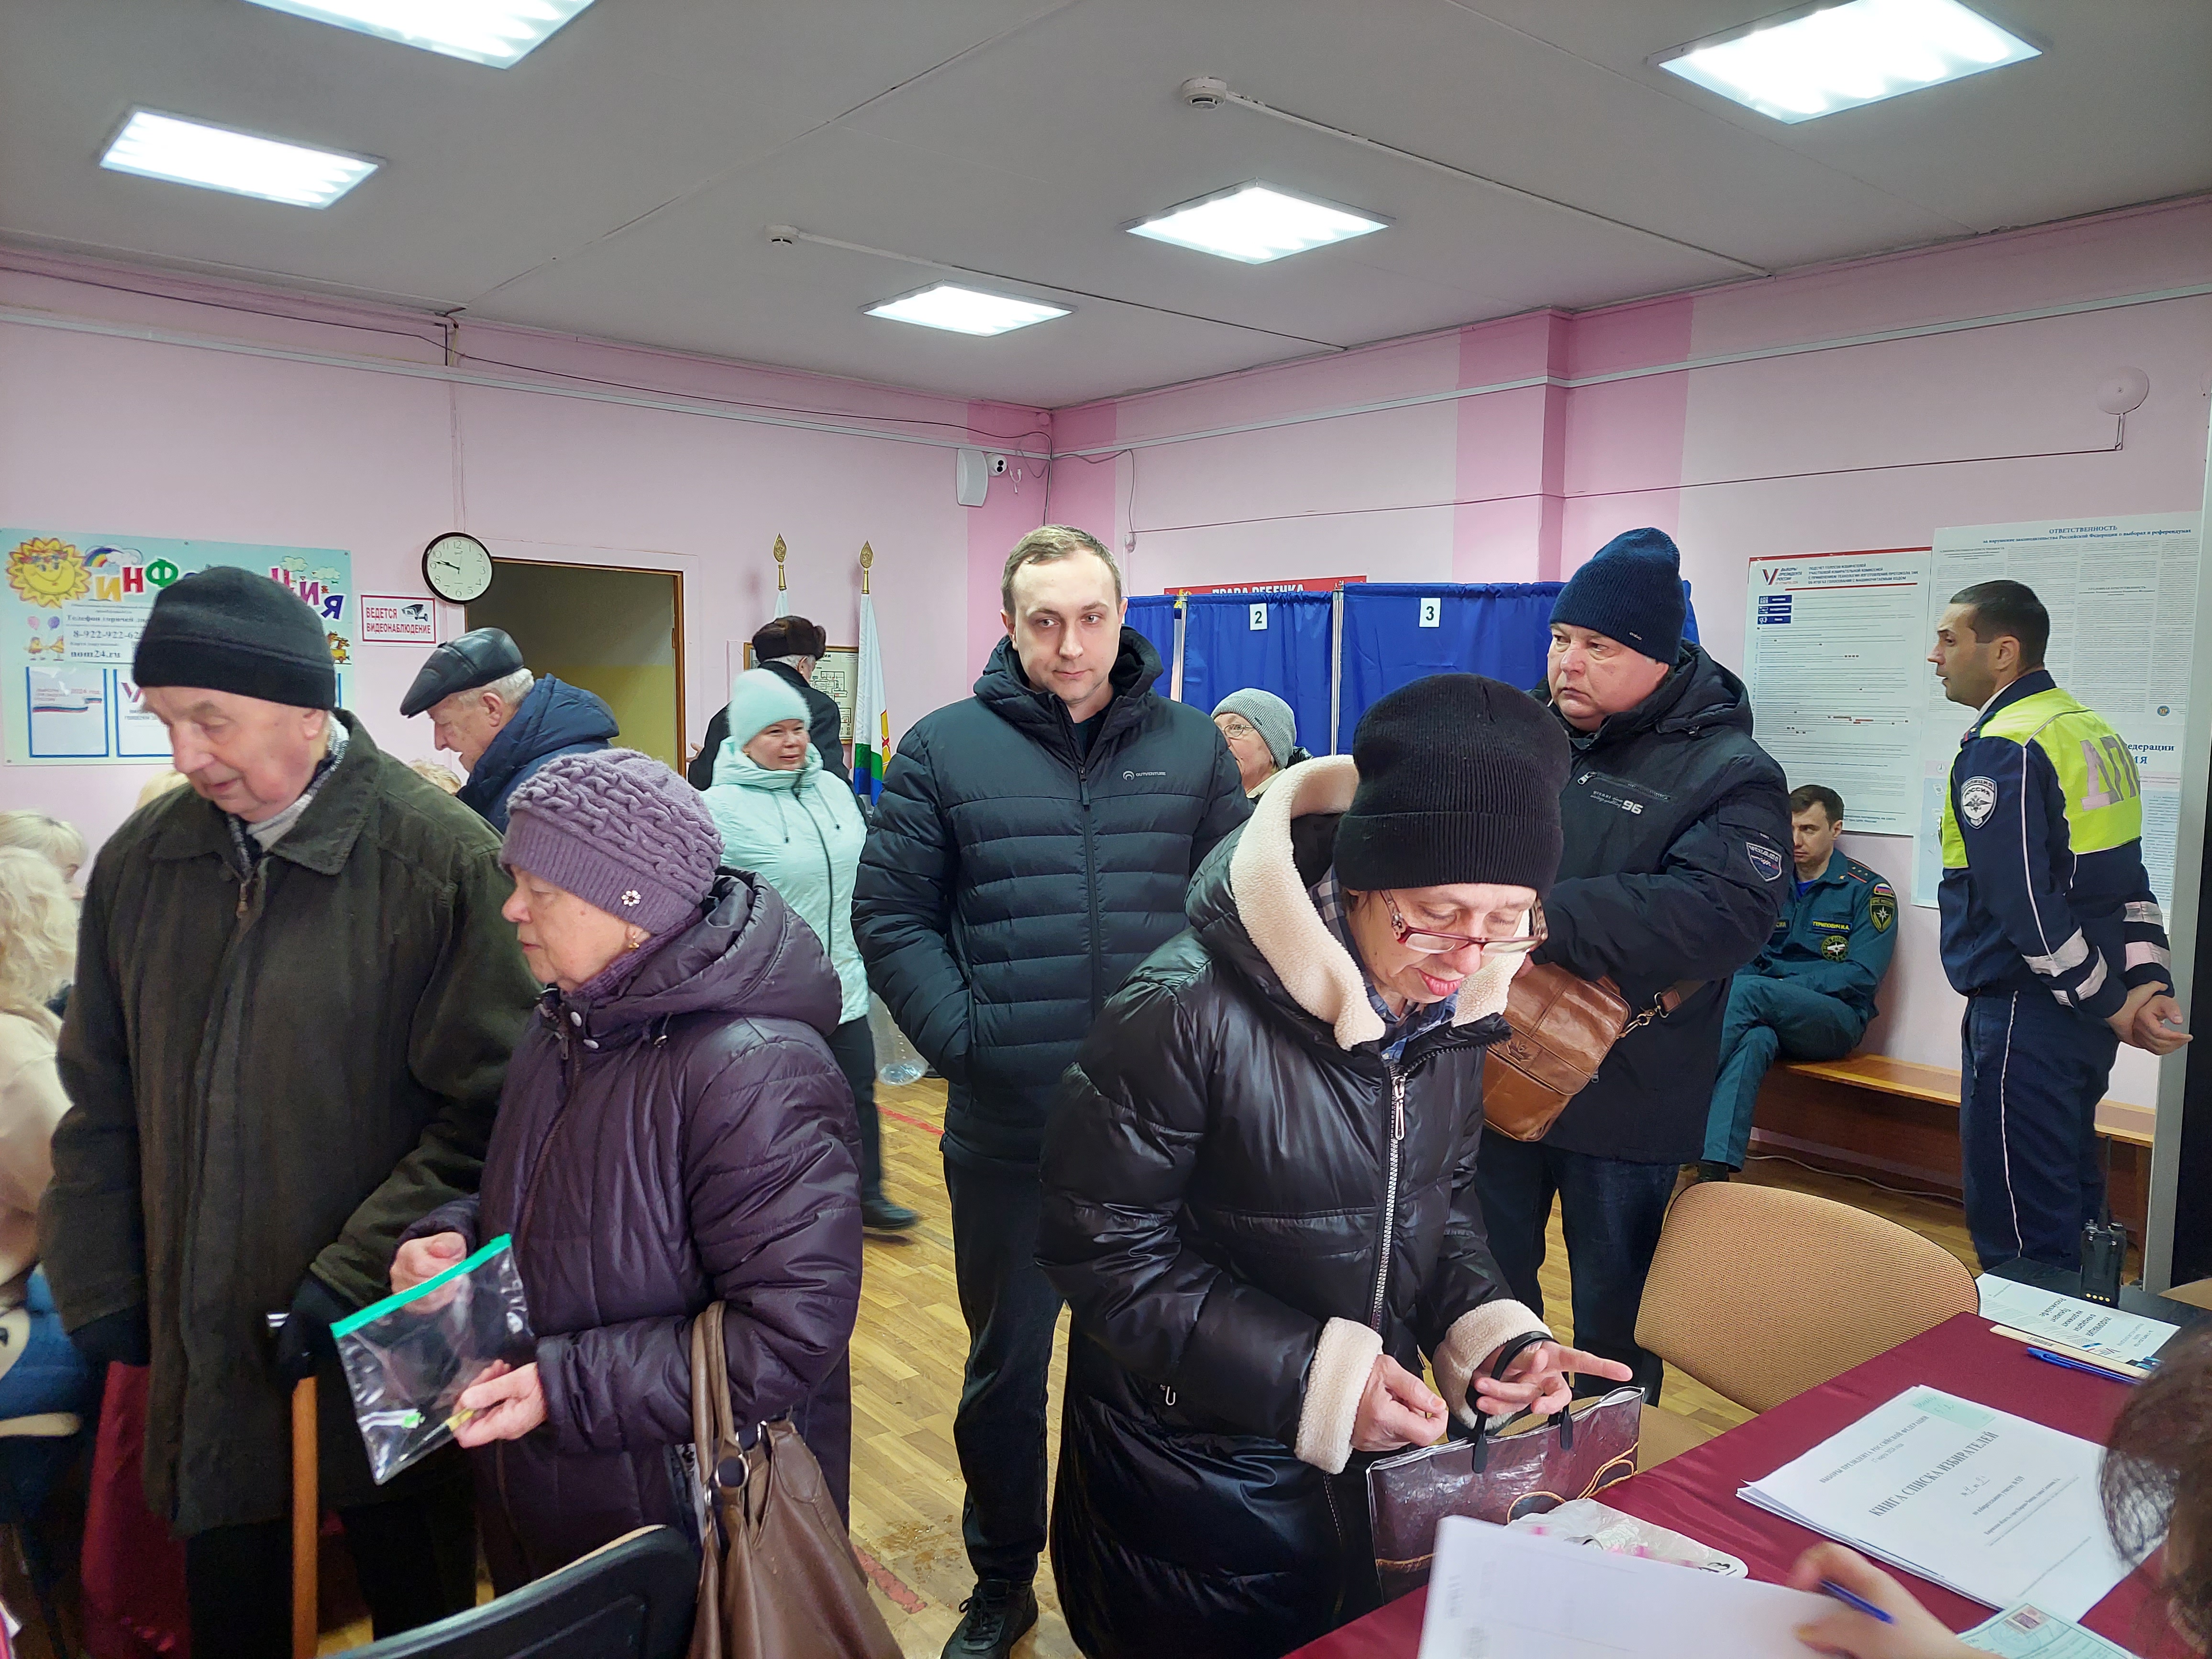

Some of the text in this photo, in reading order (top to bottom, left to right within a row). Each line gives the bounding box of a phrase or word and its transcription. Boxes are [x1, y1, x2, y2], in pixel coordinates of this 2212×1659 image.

[2049, 526, 2117, 534] ОТВЕТСТВЕННОСТЬ
[95, 558, 344, 620] ИНФЦИЯ
[366, 608, 398, 620] ВЕДЕТСЯ
[1254, 610, 1262, 624] 2
[1426, 606, 1434, 621] 3
[366, 623, 431, 635] ВИДЕОНАБЛЮДЕНИЕ
[2127, 744, 2175, 752] едерации
[1622, 800, 1644, 814] 96
[1819, 1415, 1929, 1483] ВЫБОРЫ ПРЕЗИДЕНТА РОССИЙСКОЙ ФЕДЕРАЦИИ
[1869, 1431, 2000, 1516] КНИГА СПИСКА ИЗБИРАТЕЛЕЙ
